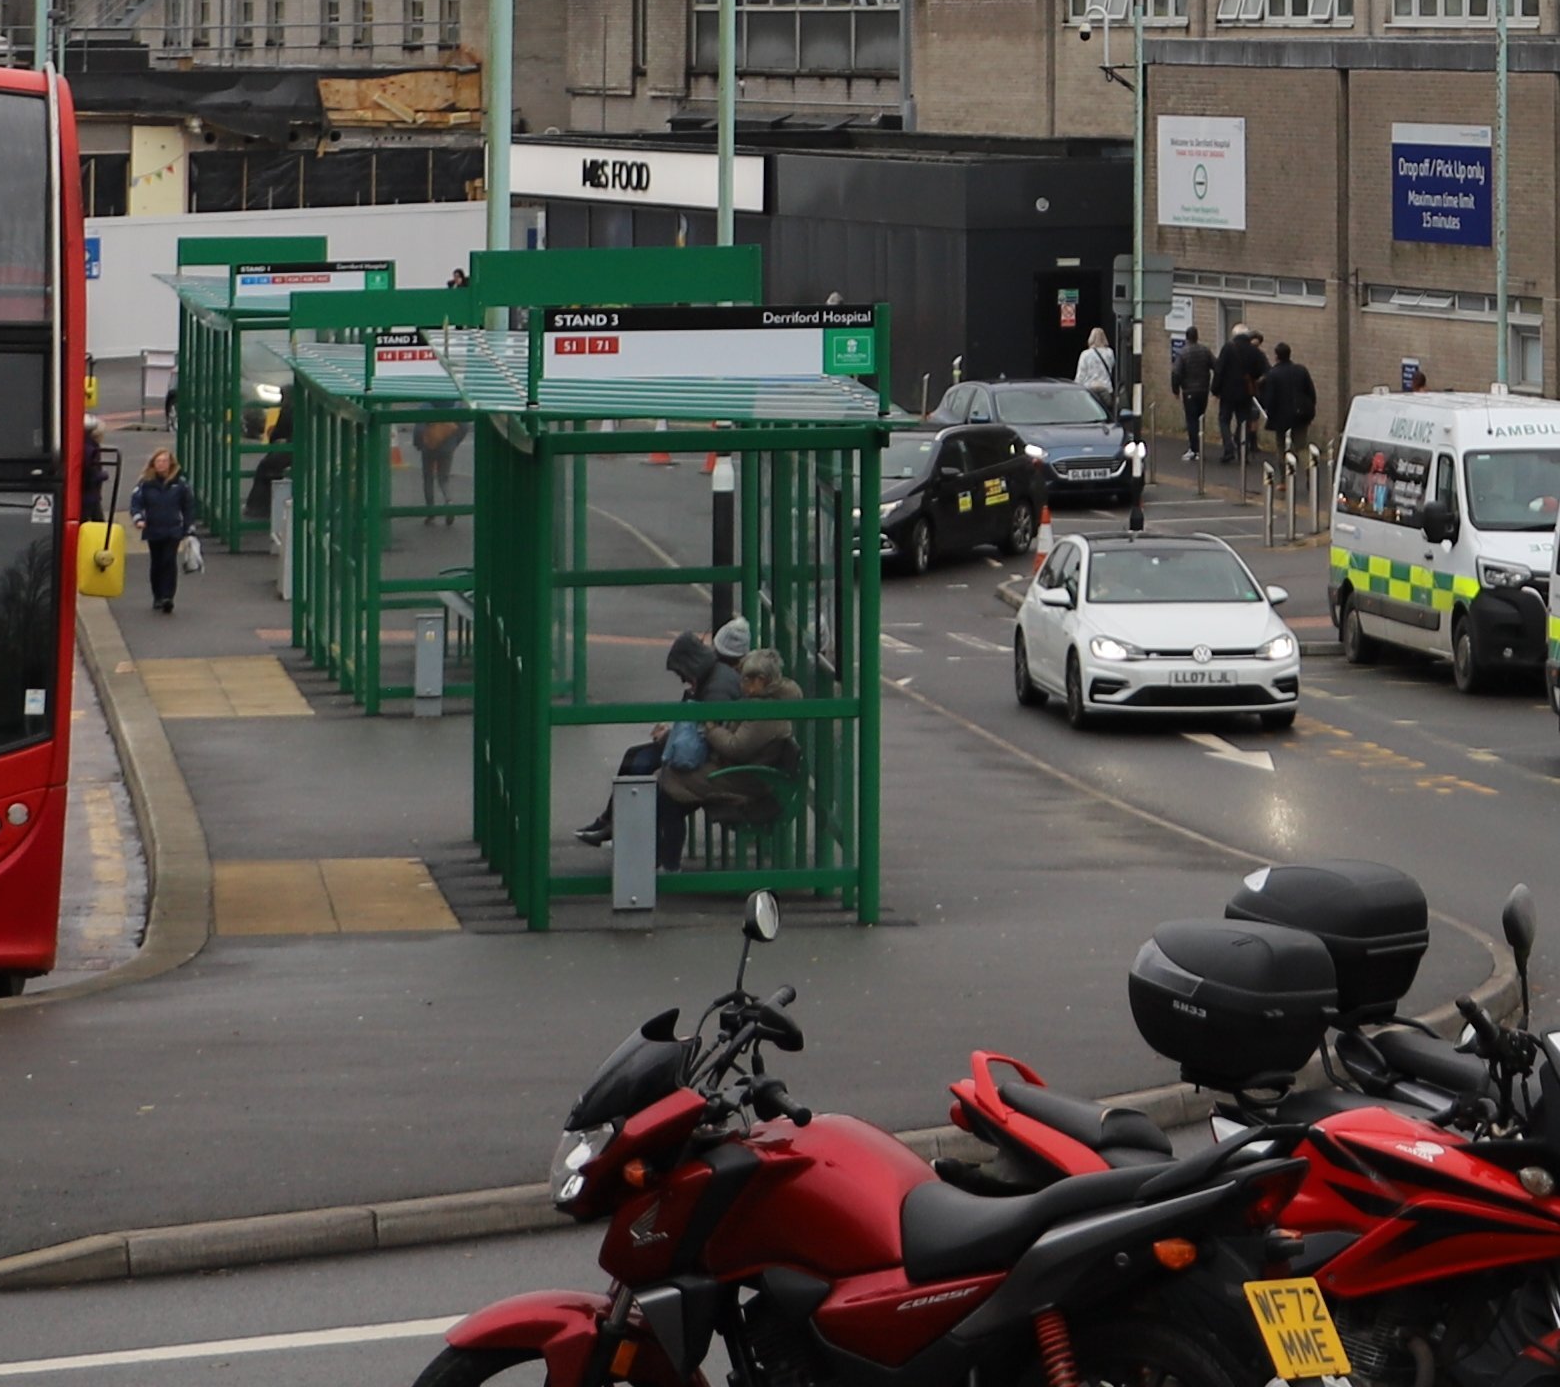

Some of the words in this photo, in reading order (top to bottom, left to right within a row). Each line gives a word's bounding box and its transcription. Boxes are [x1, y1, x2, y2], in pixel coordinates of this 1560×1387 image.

[611, 159, 650, 191] FOOD
[1398, 157, 1418, 181] Drop
[1419, 158, 1431, 177] off
[1436, 158, 1453, 178] Pick
[1454, 160, 1466, 184] Up
[1467, 160, 1485, 185] only
[1407, 189, 1442, 207] Maximum
[1442, 191, 1458, 208] time
[1459, 192, 1476, 210] limit
[1422, 211, 1431, 228] 15
[1432, 212, 1461, 230] minutes
[554, 313, 607, 326] STAND
[610, 314, 619, 326] 3
[762, 311, 819, 324] Derriford
[822, 310, 872, 325] Hospital
[376, 335, 410, 345] STAND
[412, 335, 418, 344] 2
[563, 339, 577, 351] 51
[596, 339, 610, 351] 71
[1252, 1287, 1327, 1325] WF72
[1277, 1327, 1335, 1365] MME
